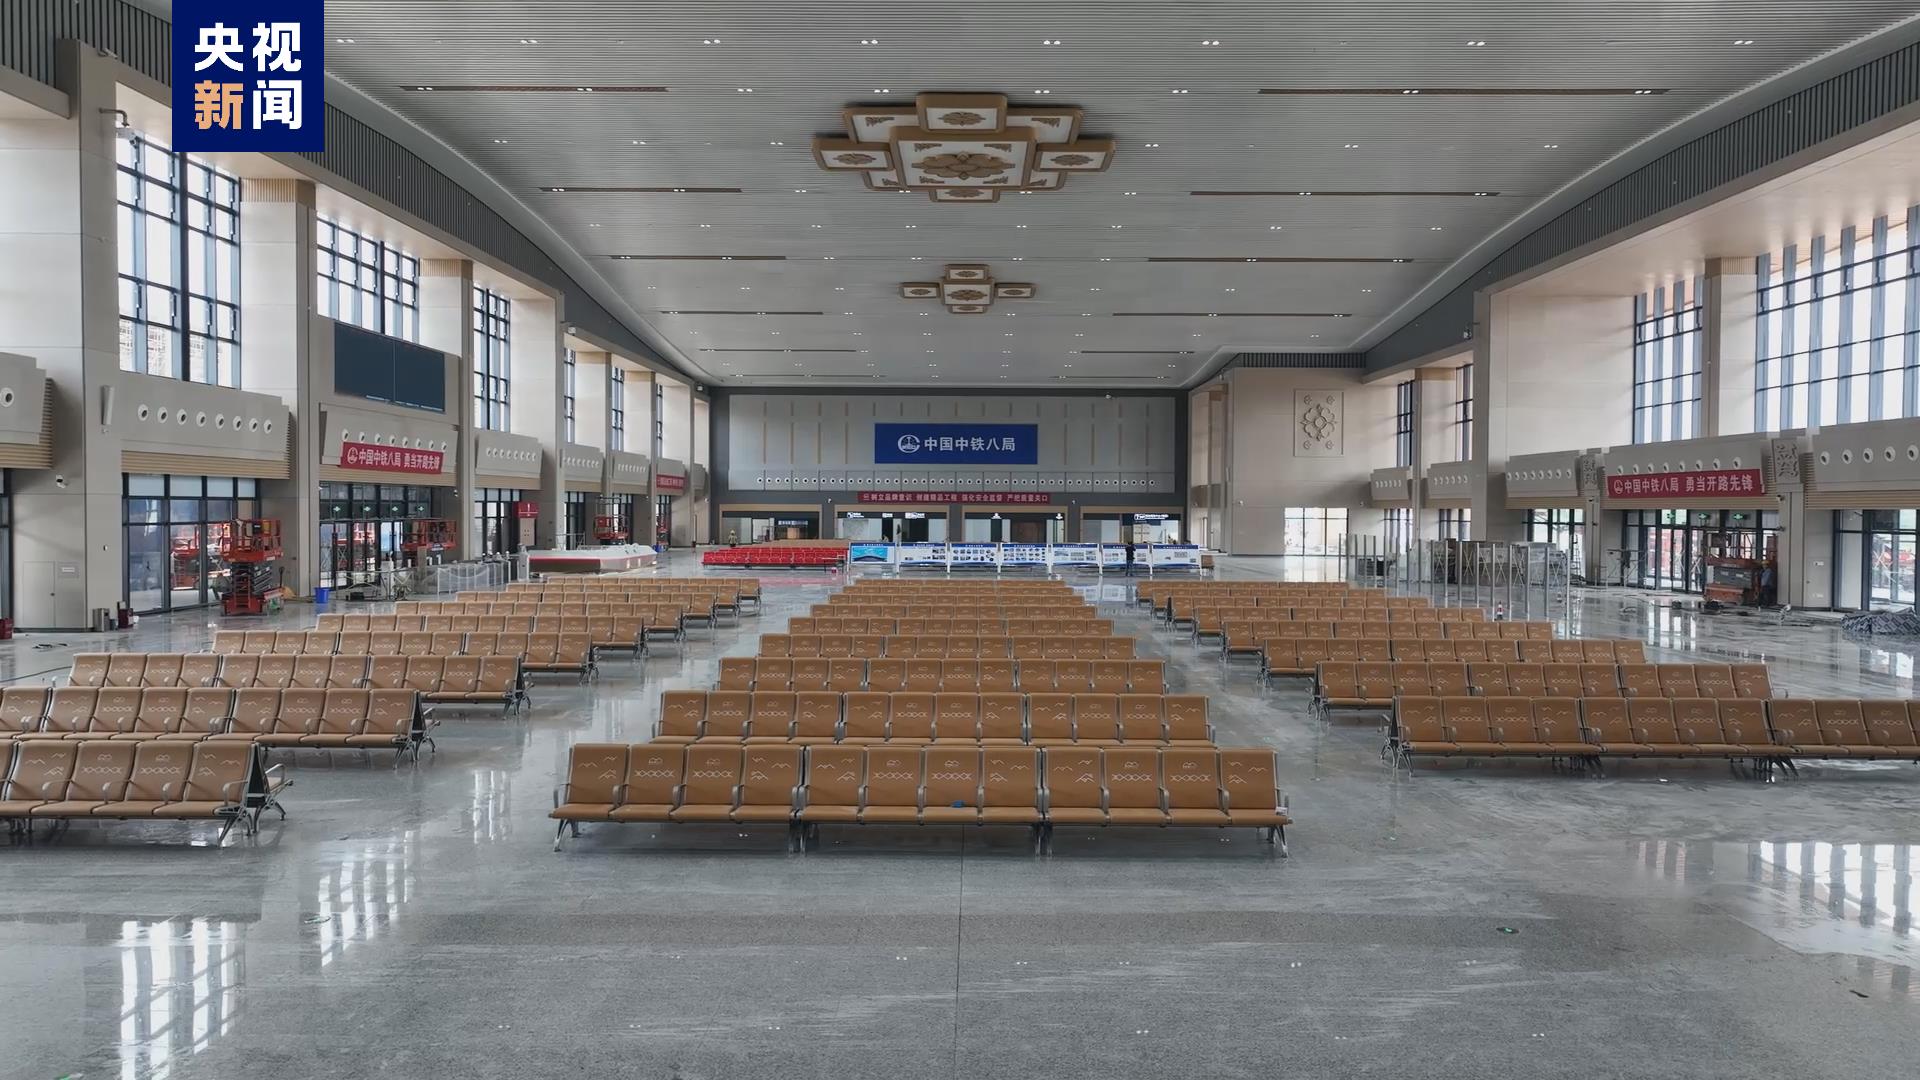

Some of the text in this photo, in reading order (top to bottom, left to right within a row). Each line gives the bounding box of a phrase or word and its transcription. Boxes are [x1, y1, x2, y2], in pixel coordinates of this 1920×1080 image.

[924, 436, 1015, 452] 中国中铁八局
[359, 448, 401, 467] 中国中铁八局
[1624, 474, 1753, 494] 中国中铁八局 勇当开路先锋
